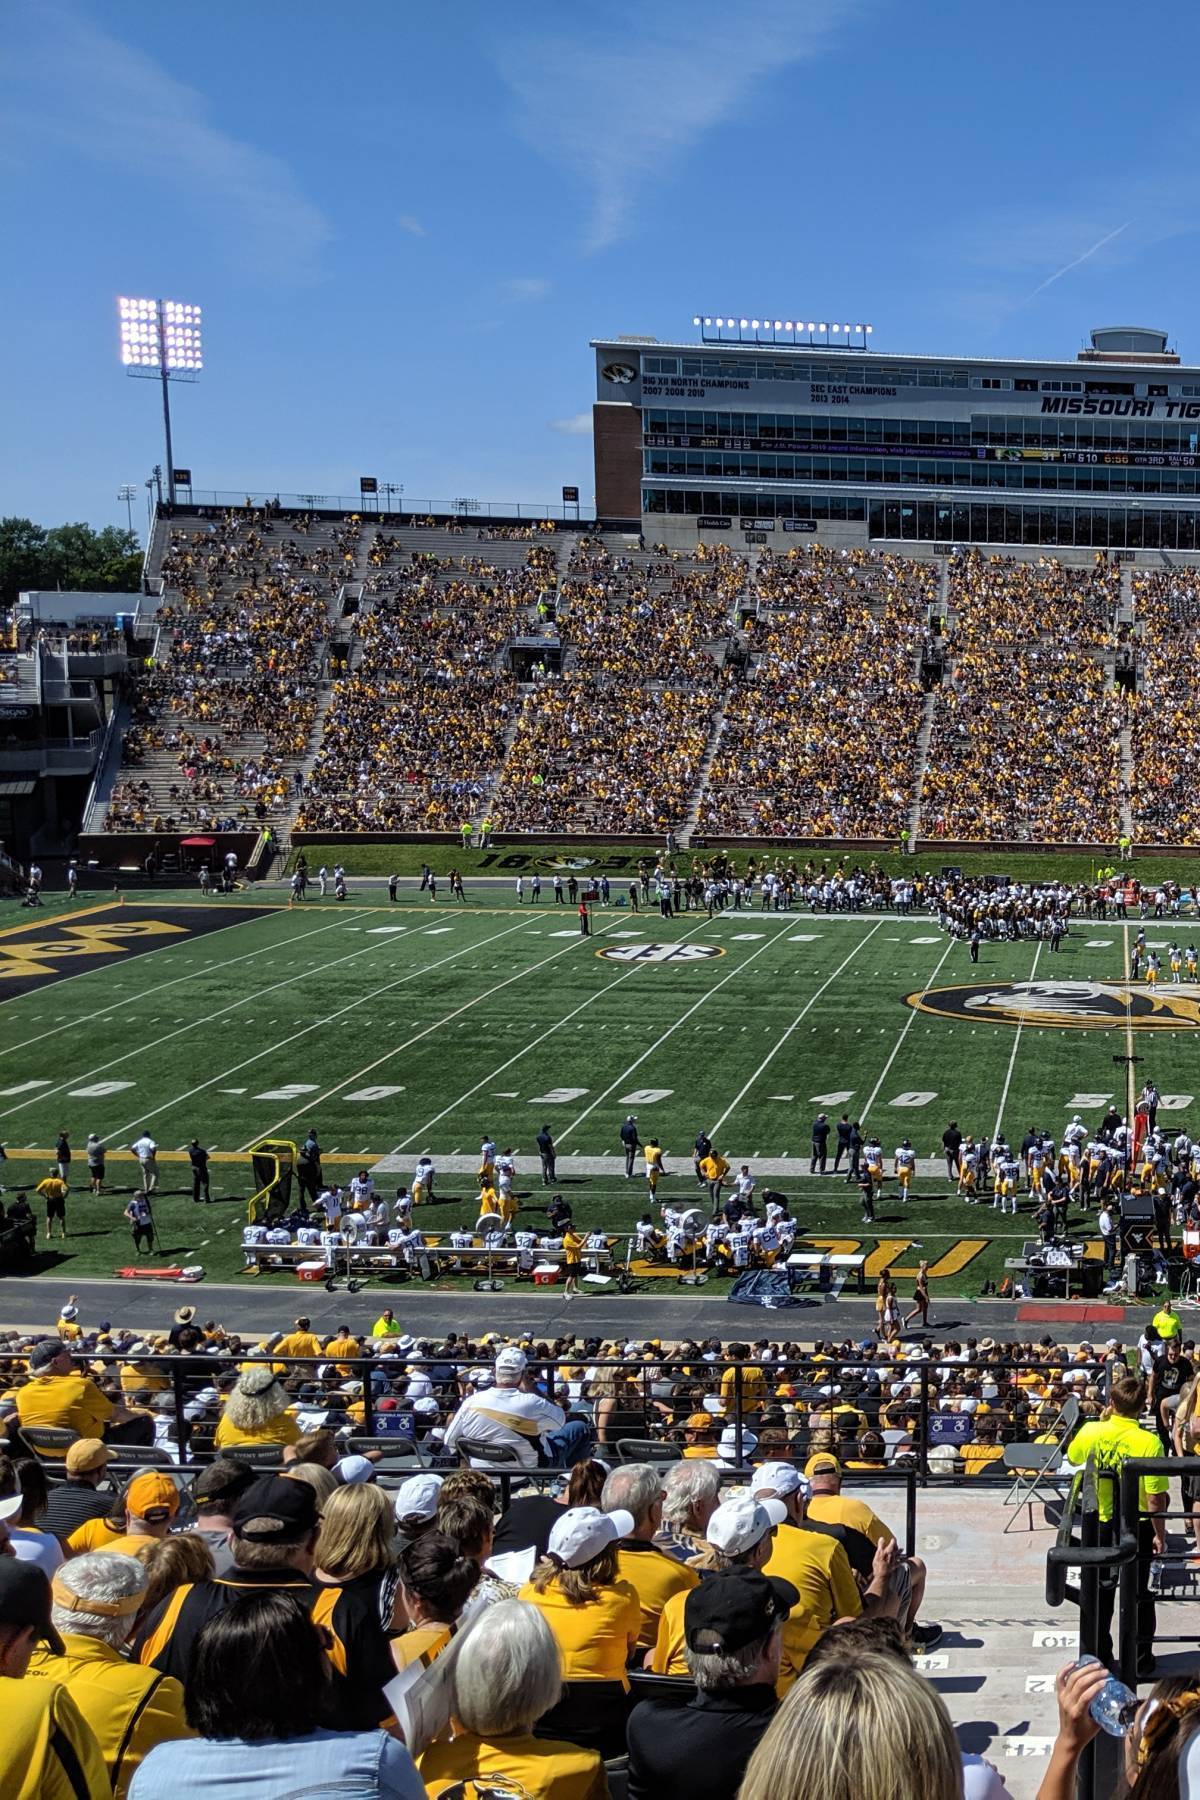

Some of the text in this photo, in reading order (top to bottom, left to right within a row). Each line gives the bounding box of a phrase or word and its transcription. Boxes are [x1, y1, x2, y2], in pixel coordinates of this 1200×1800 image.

[642, 376, 750, 390] BIG XII NORTH CHAMPIONS
[642, 386, 705, 398] 2007 2008 2010
[810, 384, 897, 396] SEC EAST CHAMPIONS
[811, 394, 849, 404] 2013 2014
[1041, 396, 1155, 417] MISSOURI
[1041, 452, 1055, 461] 31
[1086, 454, 1098, 463] 10
[1183, 457, 1195, 466] 50
[710, 1229, 726, 1240] 76
[762, 1227, 776, 1243] 69
[516, 1236, 531, 1248] 32
[733, 1235, 748, 1248] 68
[304, 1272, 312, 1280] G
[541, 1275, 549, 1284] G
